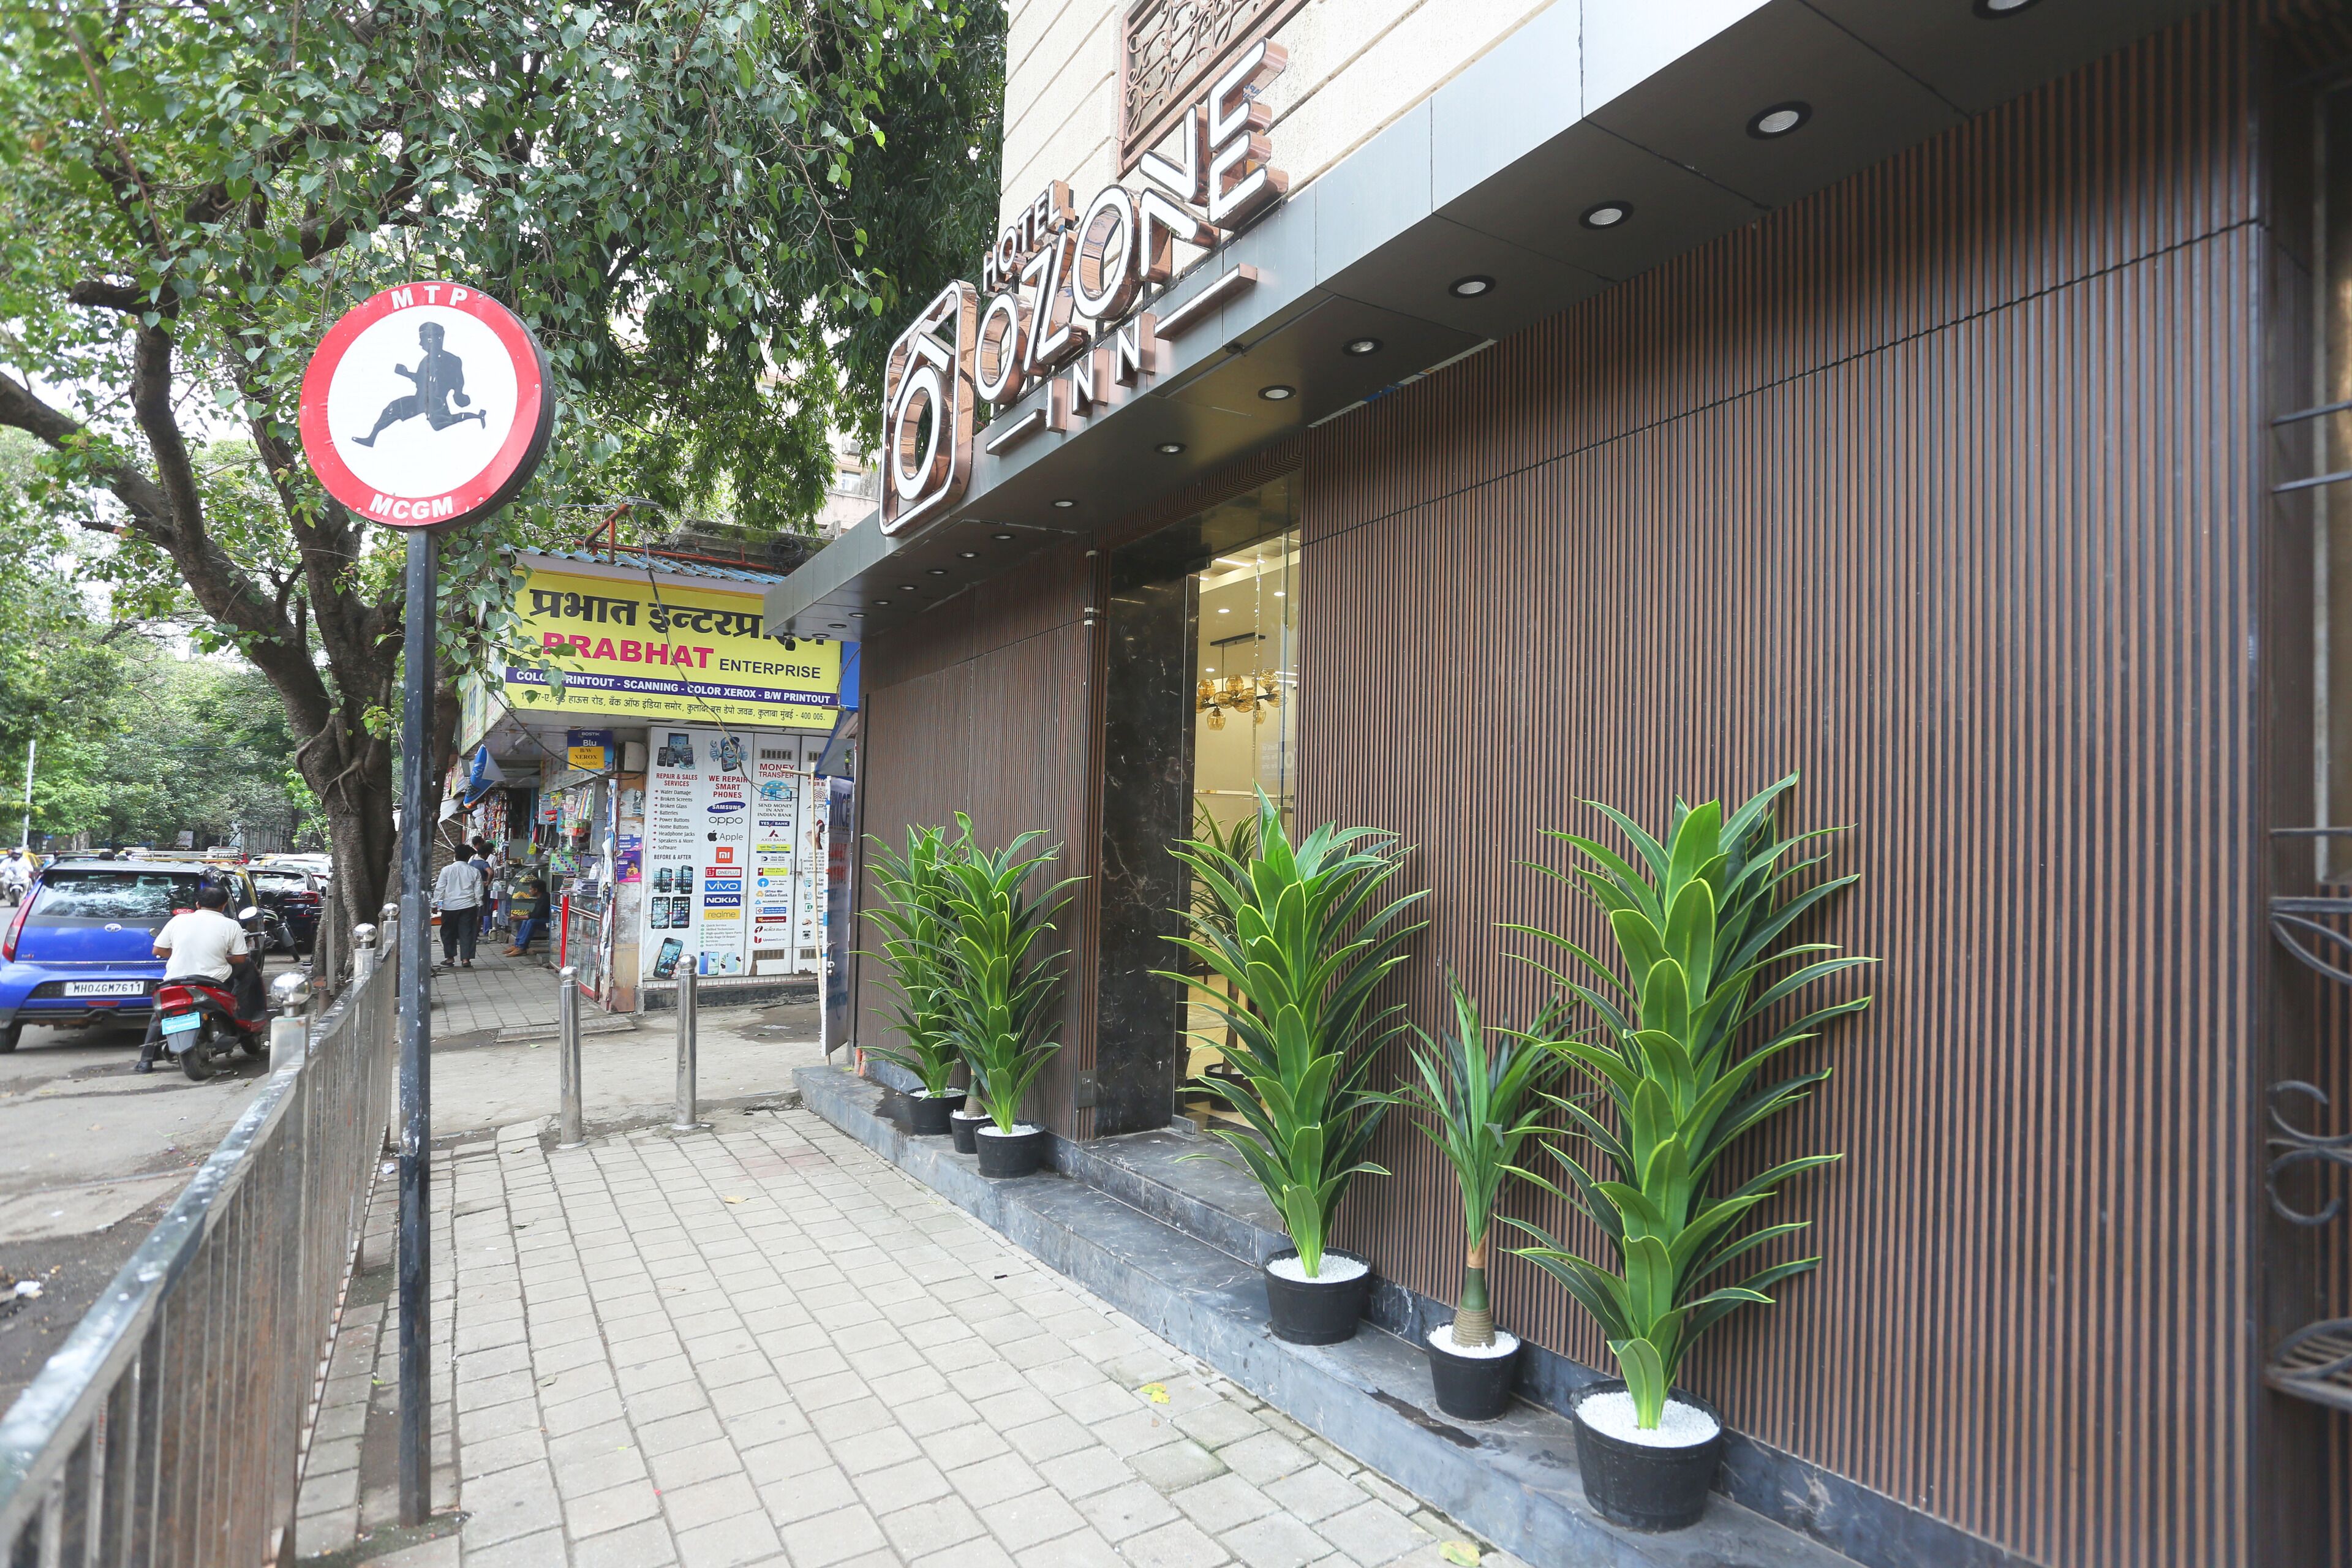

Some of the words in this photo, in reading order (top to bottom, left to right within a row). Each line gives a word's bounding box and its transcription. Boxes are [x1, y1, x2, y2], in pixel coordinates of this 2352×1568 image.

[974, 38, 1277, 403] OZONE
[983, 179, 1065, 293] HOTEL
[1046, 316, 1147, 431] INN
[369, 494, 454, 519] MCGM
[529, 589, 639, 626] प्रभात
[543, 632, 714, 668] PRABHAT
[720, 658, 821, 679] ENTERPRISE
[564, 675, 614, 687] RINTOUT
[624, 680, 679, 692] SCANNING
[687, 685, 721, 696] COLOR
[723, 688, 756, 698] XEROX
[764, 691, 782, 701] B/W
[783, 692, 831, 704] PRINTOUT
[568, 695, 589, 704] हाऊस
[624, 697, 639, 707] ऑफ
[643, 698, 662, 710] इंडिया
[723, 705, 734, 714] डेपो
[758, 709, 778, 719] कुलाबा
[780, 709, 794, 721] मुंबई
[719, 833, 743, 842] Apple
[74, 982, 141, 993] MH04GM7611
